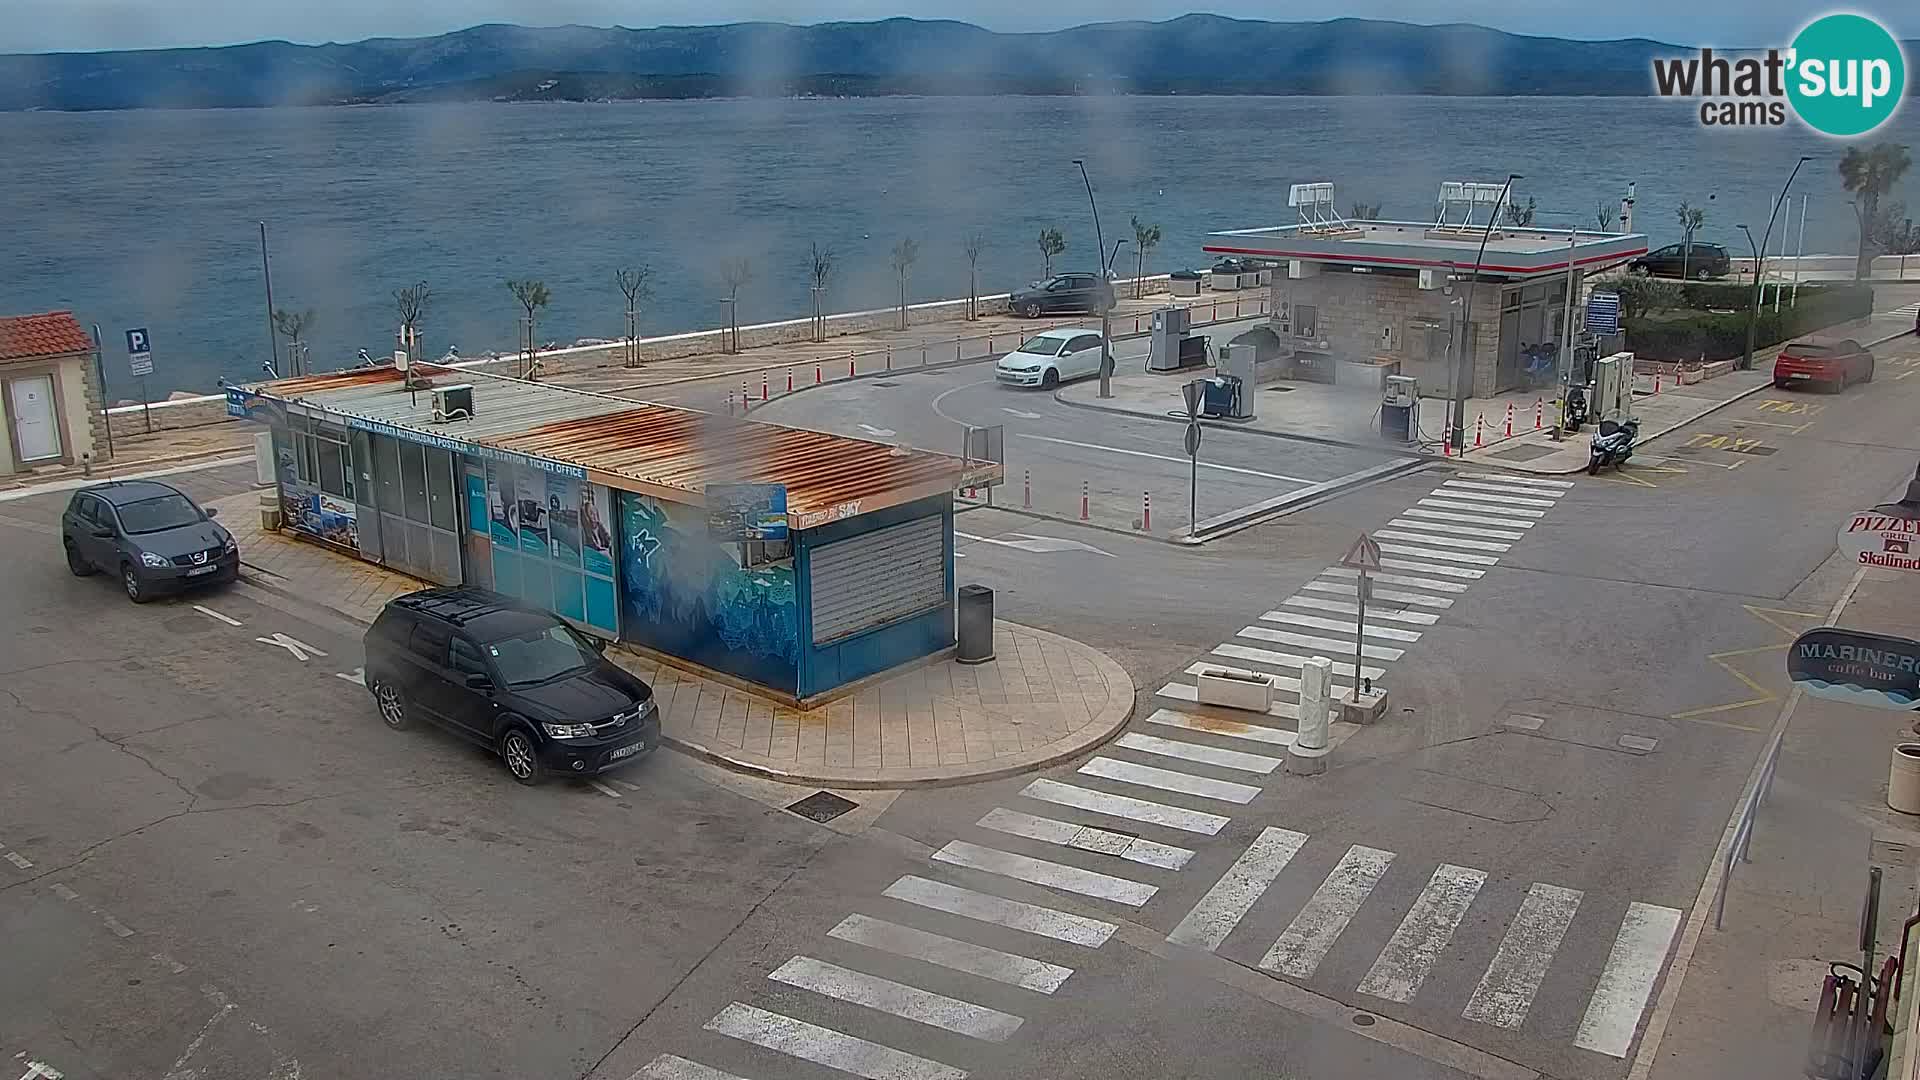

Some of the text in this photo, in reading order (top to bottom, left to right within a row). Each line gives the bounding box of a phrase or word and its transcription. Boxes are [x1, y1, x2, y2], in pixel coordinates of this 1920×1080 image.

[131, 332, 144, 350] P
[1759, 399, 1826, 416] TAXI
[1684, 431, 1763, 453] TAXI
[397, 427, 437, 445] AUTOBUSNA
[437, 437, 468, 452] POSTAJA
[479, 447, 493, 458] BUS
[495, 450, 527, 465] STATION
[528, 458, 554, 472] TICKET
[556, 463, 583, 478] OFFICE
[1880, 531, 1917, 542] GRILL
[1869, 666, 1896, 681] bar
